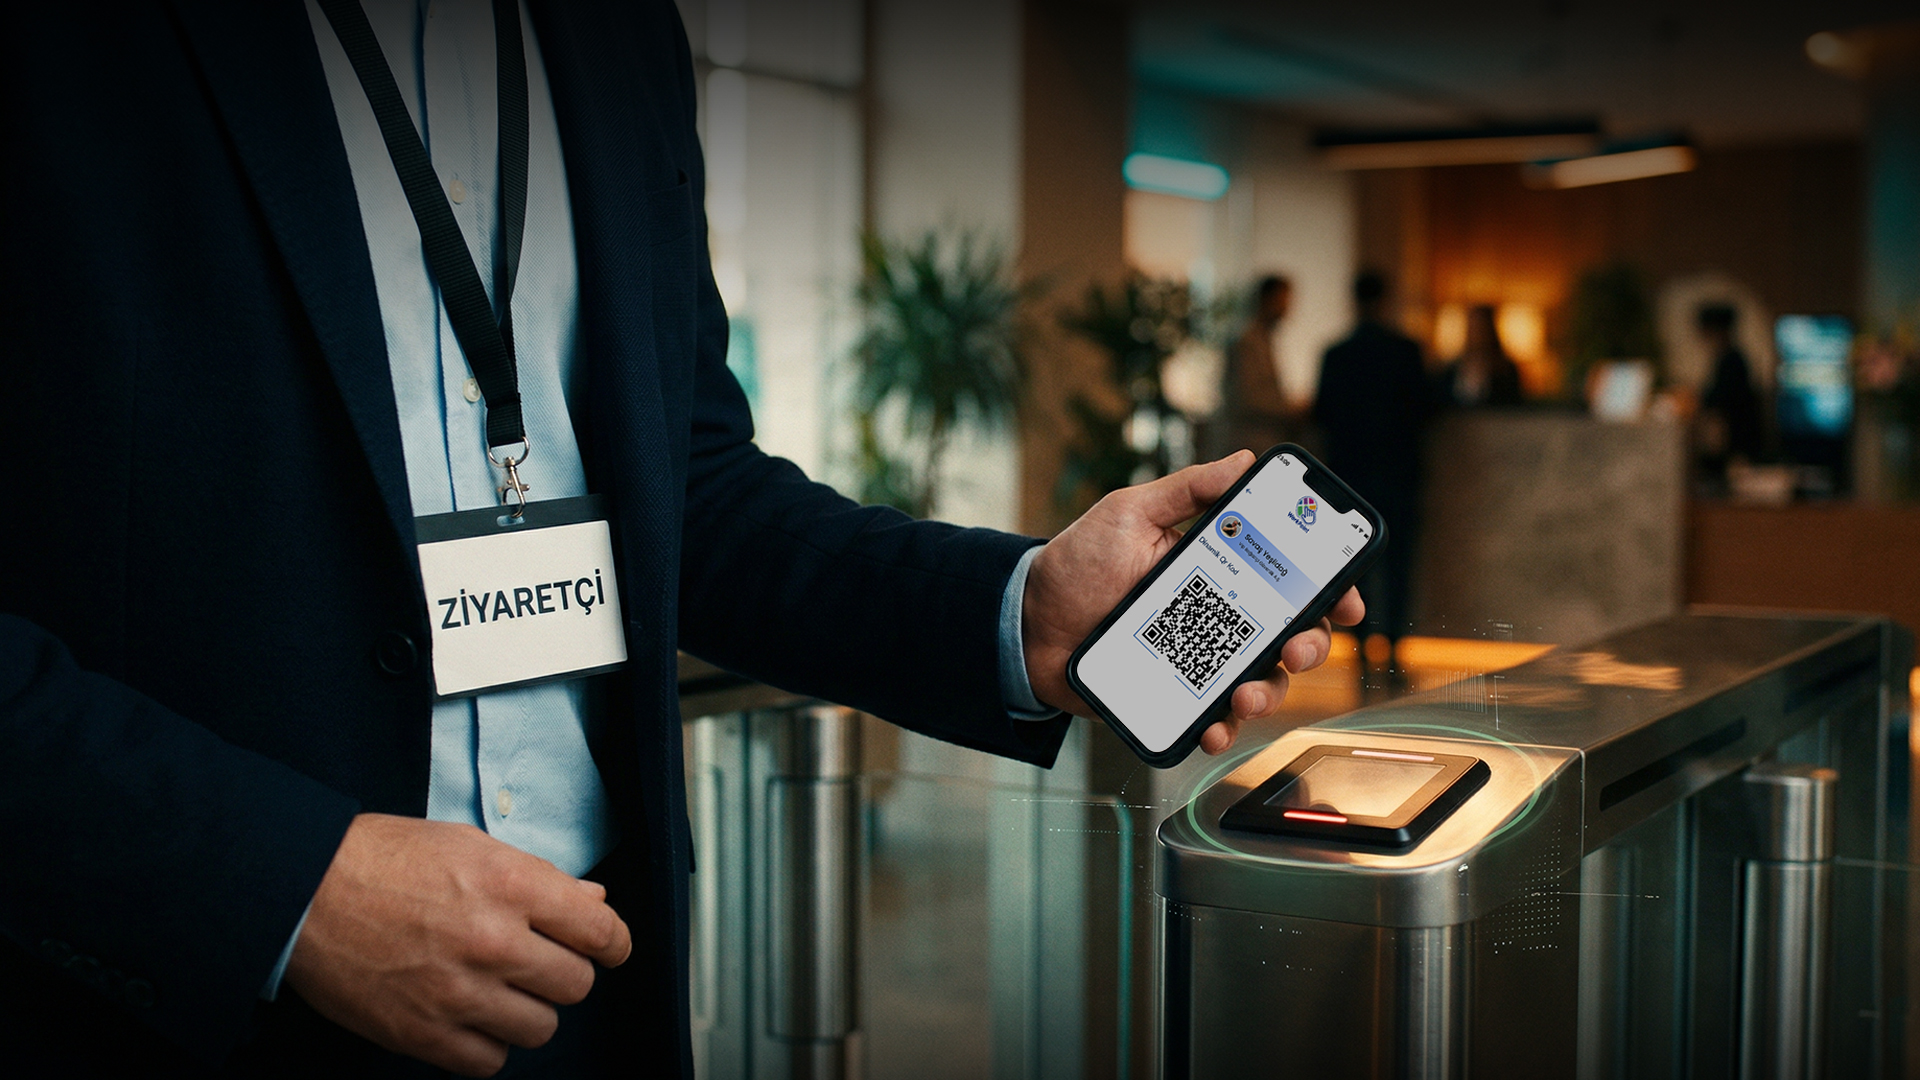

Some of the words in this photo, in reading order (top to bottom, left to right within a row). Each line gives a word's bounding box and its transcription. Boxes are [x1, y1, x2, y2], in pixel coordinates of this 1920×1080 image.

[1287, 511, 1310, 534] WorkPoint
[1244, 533, 1263, 554] Savaş
[1198, 536, 1220, 558] Dinamik
[1219, 555, 1228, 565] Qr
[1226, 562, 1240, 576] Kod
[437, 568, 605, 630] ZİYARETÇİ
[1227, 589, 1238, 600] 09
